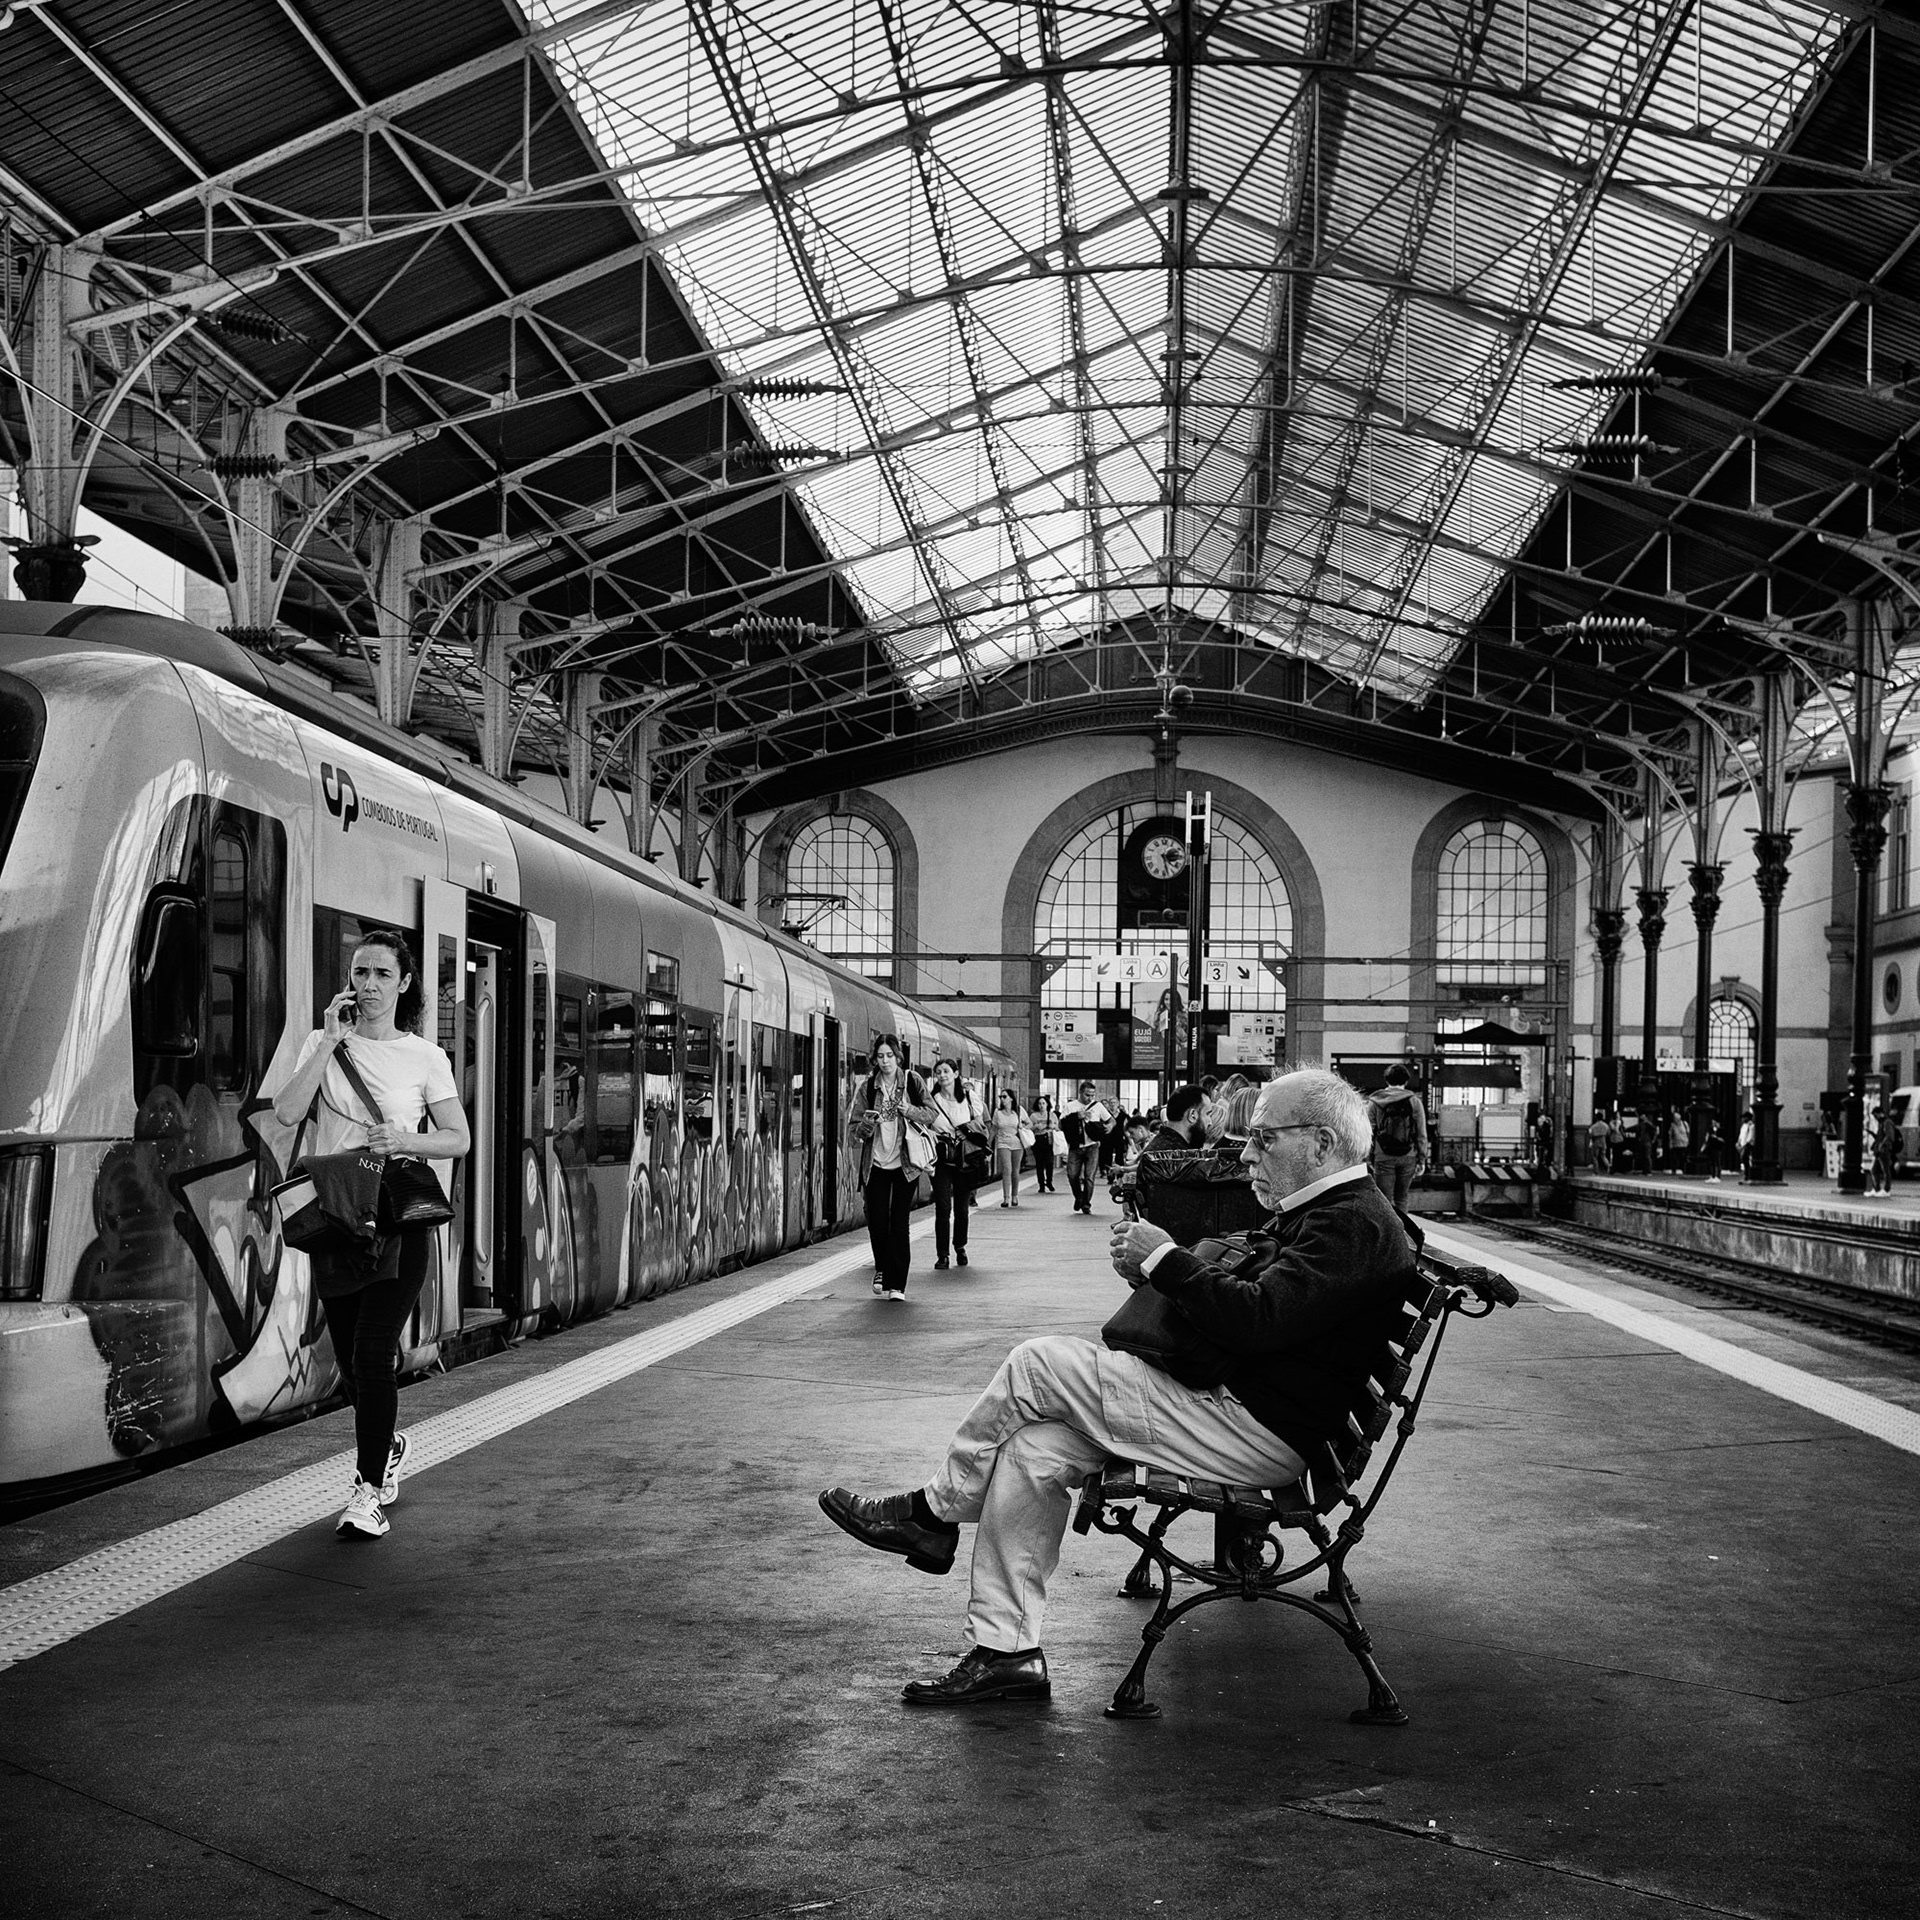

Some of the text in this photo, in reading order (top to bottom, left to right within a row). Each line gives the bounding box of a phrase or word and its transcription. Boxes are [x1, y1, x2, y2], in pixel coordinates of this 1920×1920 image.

[362, 797, 438, 842] COMBOIOS DE PORTUGAL
[1125, 965, 1135, 978] 4
[1151, 963, 1163, 976] A
[1212, 967, 1221, 981] 3
